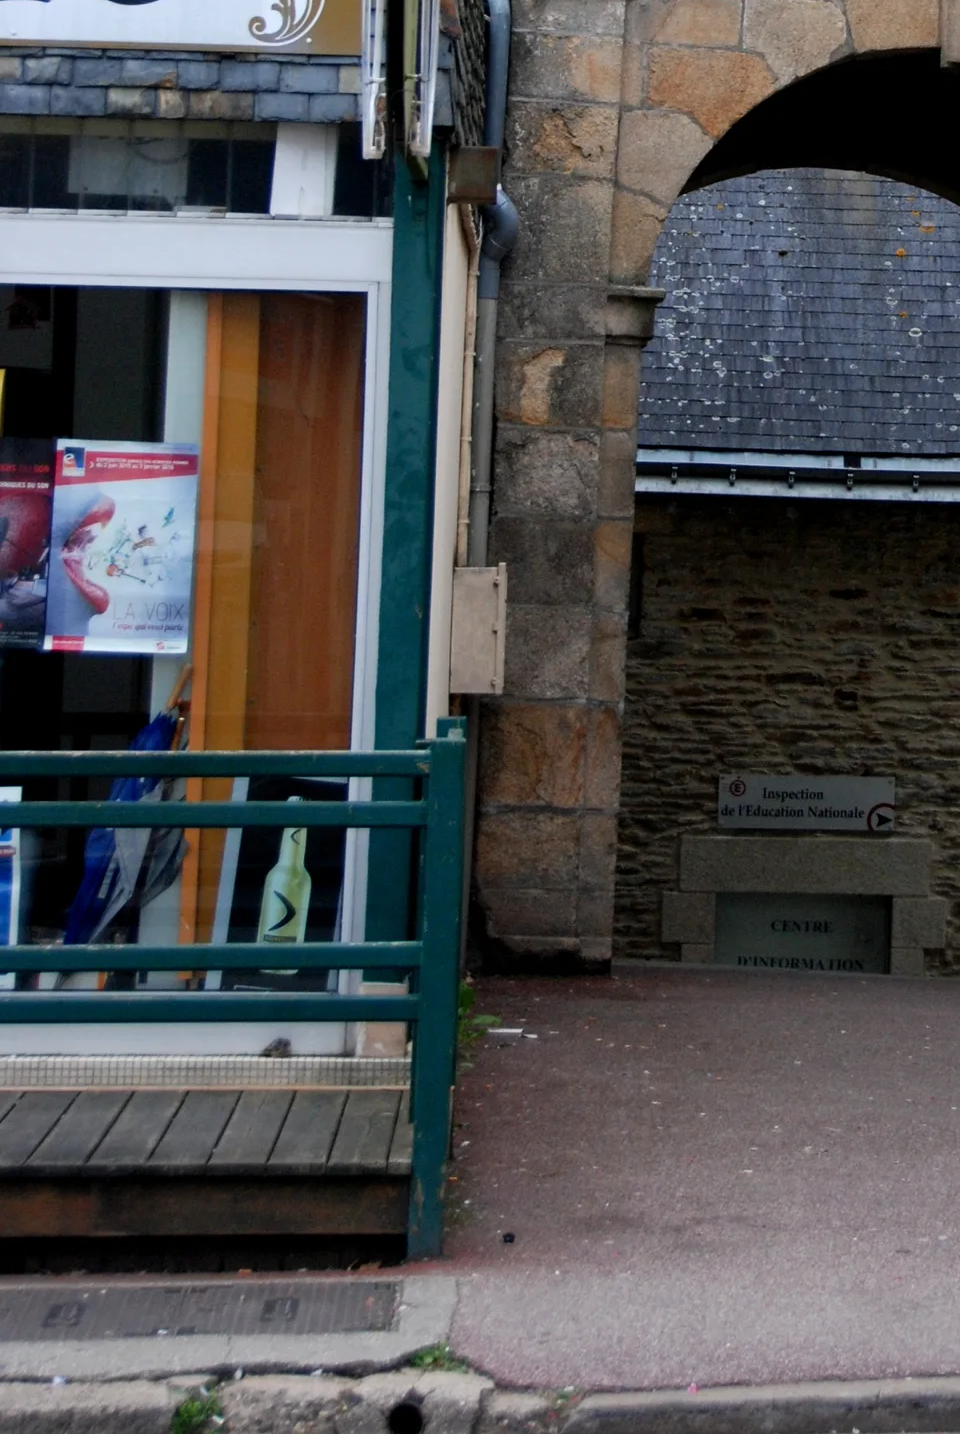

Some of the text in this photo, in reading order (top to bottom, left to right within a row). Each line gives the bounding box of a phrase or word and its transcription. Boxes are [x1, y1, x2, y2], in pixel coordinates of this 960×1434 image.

[113, 601, 185, 622] LA VOIX
[763, 787, 824, 802] Inspection
[721, 805, 865, 819] de l'Education Nationale
[770, 919, 834, 933] CENTRE
[737, 955, 864, 971] D'INFORMATION
